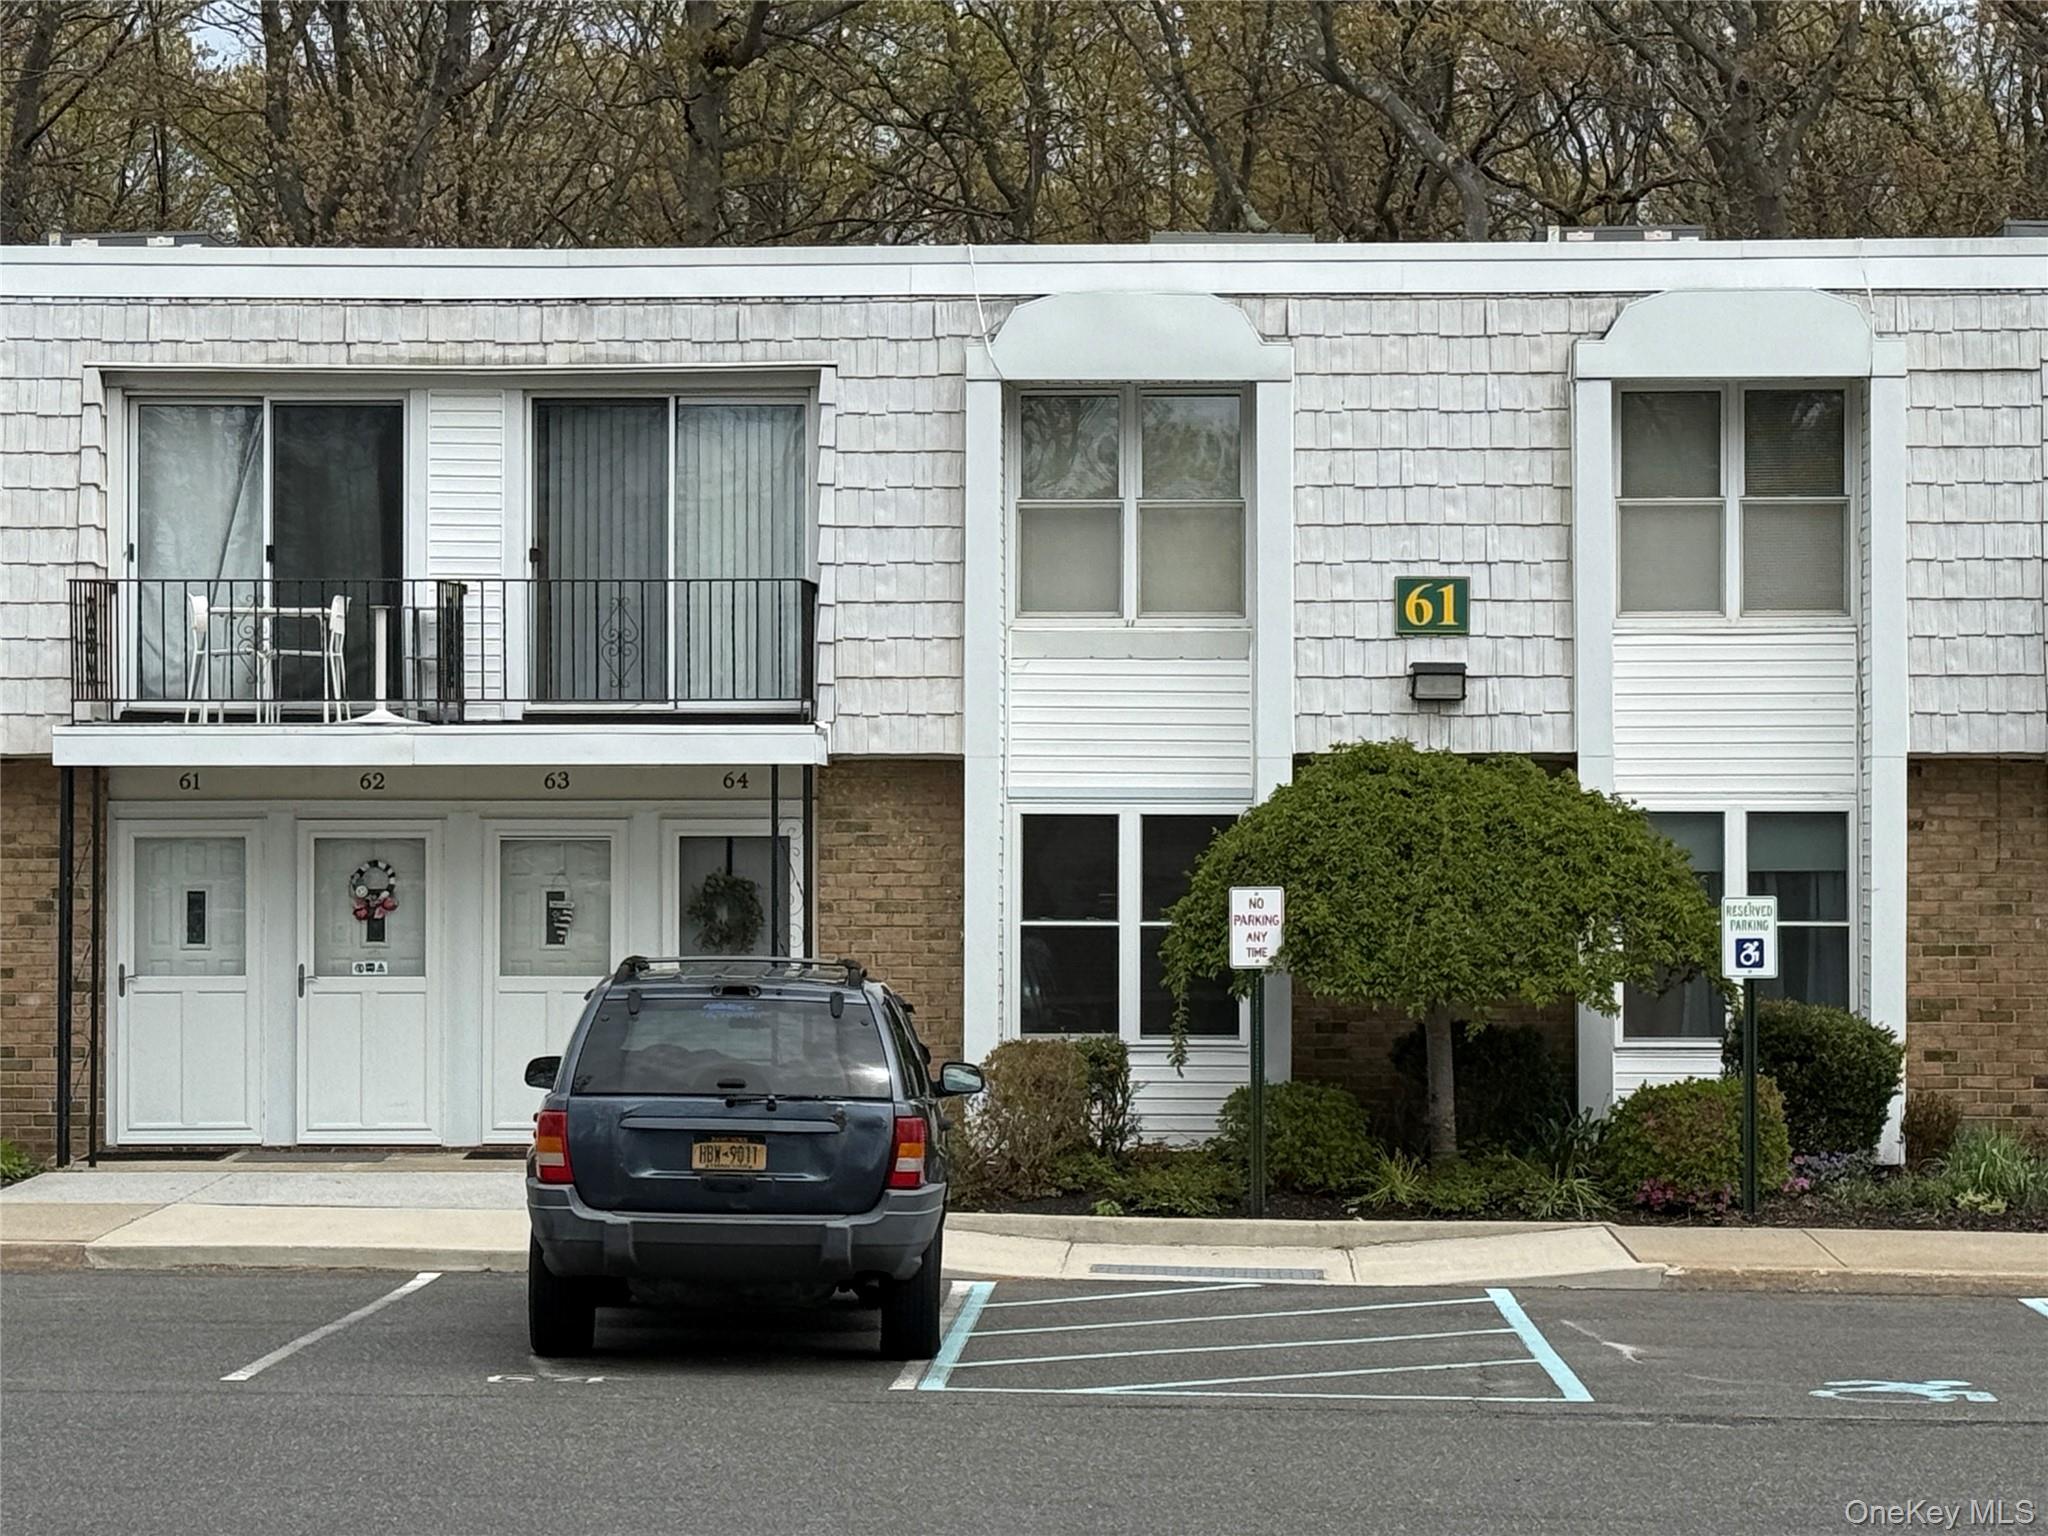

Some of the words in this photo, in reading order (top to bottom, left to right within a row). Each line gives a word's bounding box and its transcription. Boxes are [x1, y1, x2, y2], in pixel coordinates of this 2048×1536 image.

[1405, 583, 1459, 626] 61
[179, 772, 200, 790] 61
[359, 772, 385, 790] 62
[544, 771, 570, 789] 63
[723, 771, 749, 789] 64
[1248, 897, 1264, 910] NO
[1726, 904, 1773, 917] RESERVED
[1233, 914, 1280, 927] PARKING
[1730, 919, 1769, 931] PARKING
[1246, 931, 1268, 943] ANY
[1246, 947, 1268, 958] TIME
